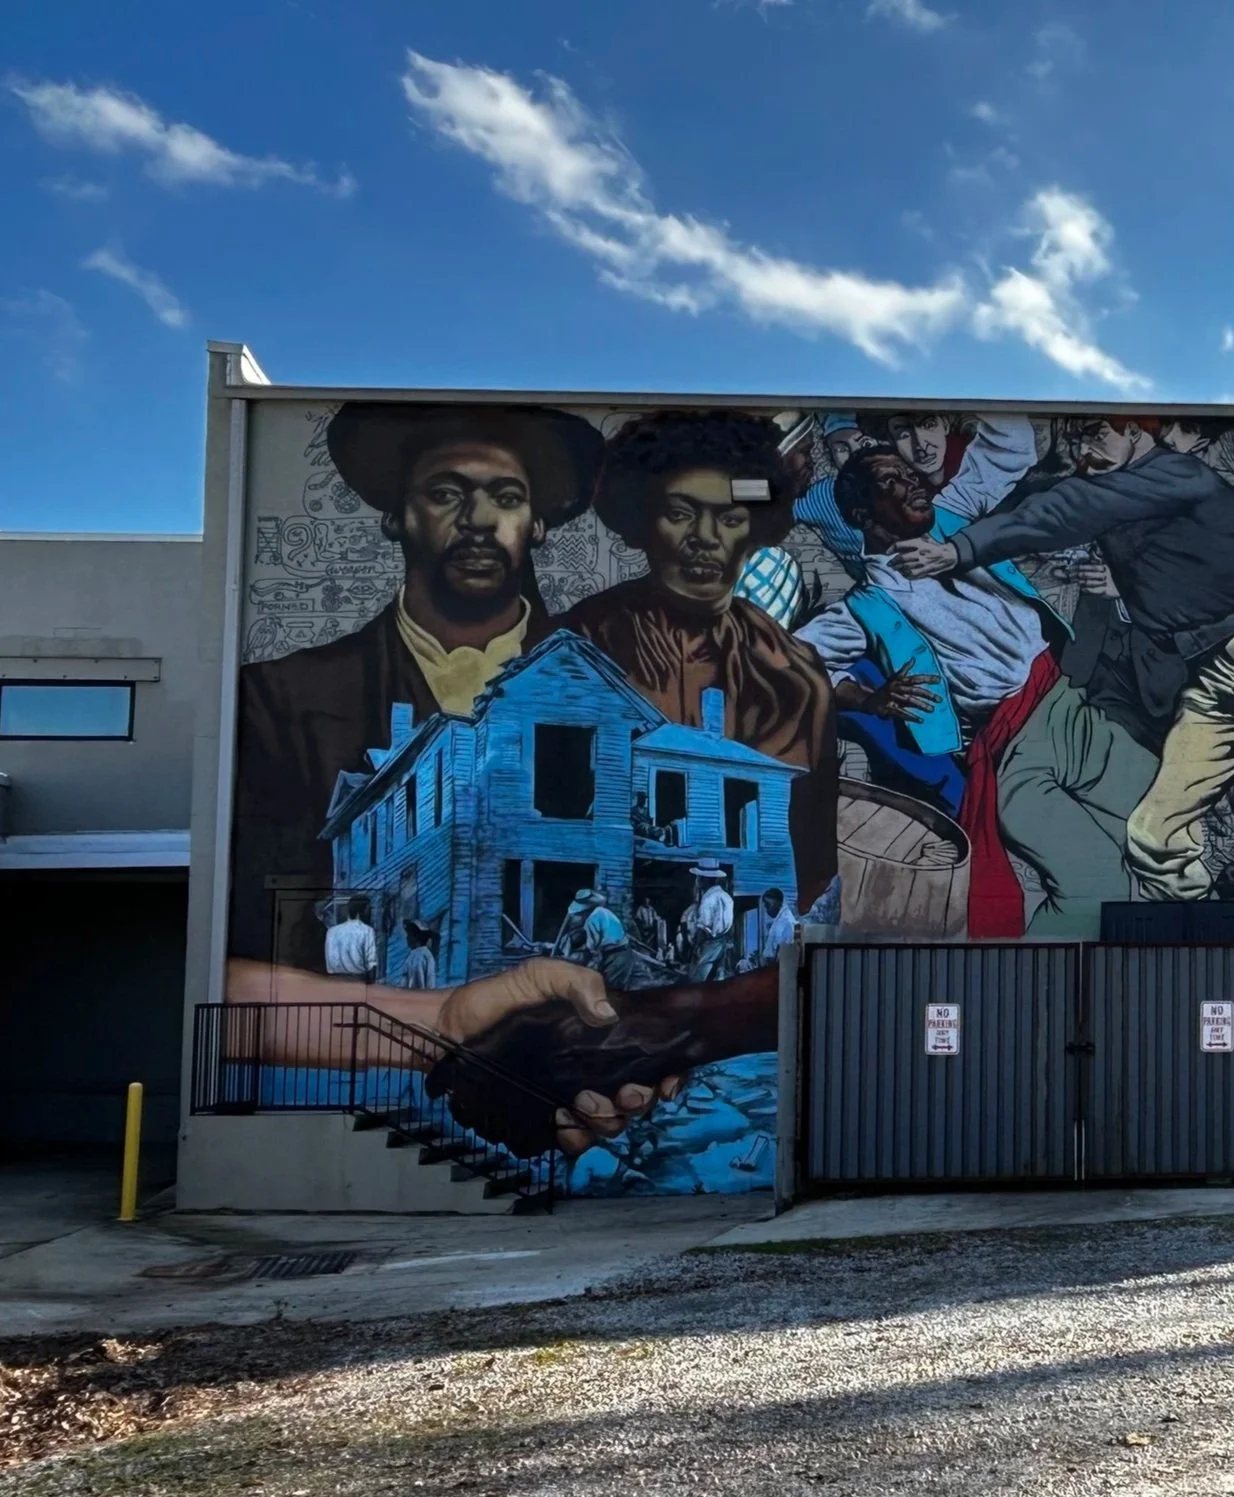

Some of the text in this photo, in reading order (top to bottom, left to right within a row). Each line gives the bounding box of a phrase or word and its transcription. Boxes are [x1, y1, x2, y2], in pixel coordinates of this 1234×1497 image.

[936, 1008, 950, 1018] NO
[1210, 1005, 1224, 1015] NO
[928, 1019, 958, 1028] PARKING
[1203, 1016, 1231, 1026] PARKING
